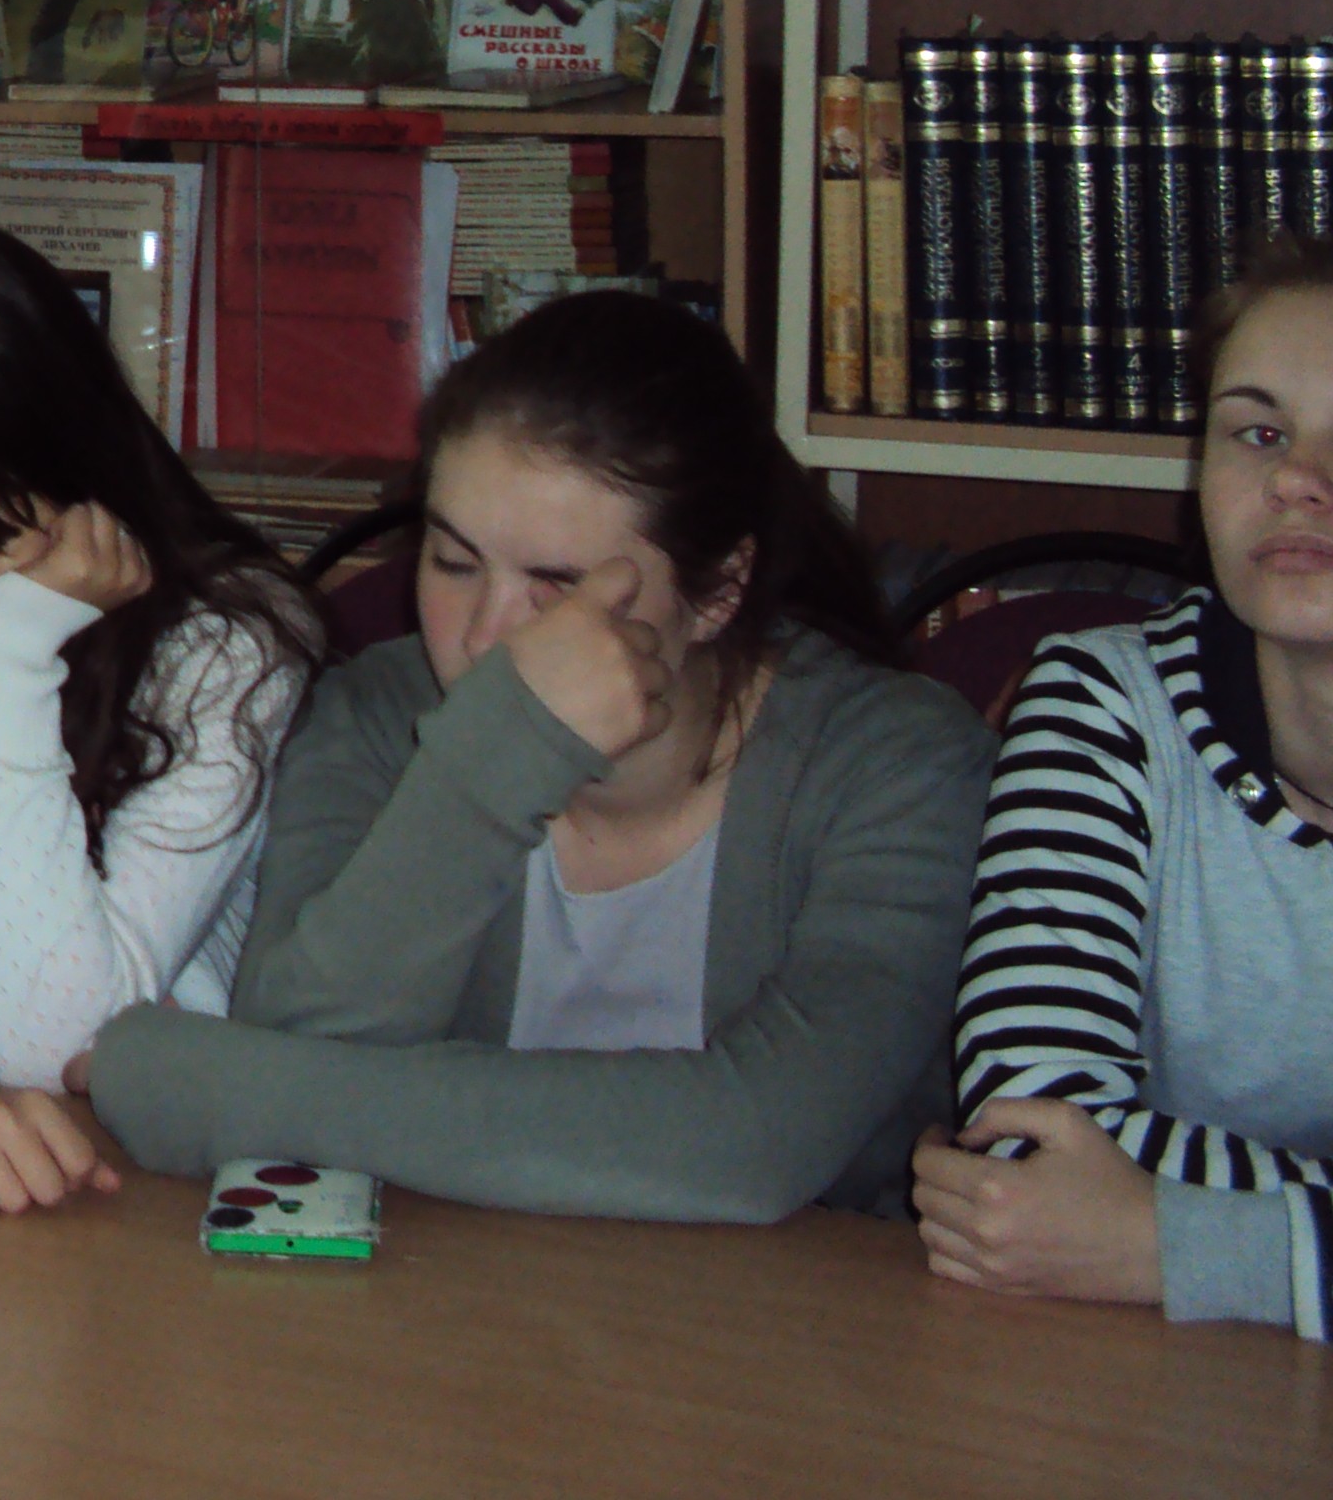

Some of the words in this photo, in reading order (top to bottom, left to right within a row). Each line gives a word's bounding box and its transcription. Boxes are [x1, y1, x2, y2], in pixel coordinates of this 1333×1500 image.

[458, 23, 564, 39] СМЕШНЫЕ
[516, 56, 528, 70] О
[534, 57, 603, 72] ШКОЛЕ
[933, 158, 954, 301] ЭНЦИКЛОПЕДИЯ
[985, 158, 1006, 302] ЭНЦИКЛОПЕДИЯ
[1077, 162, 1099, 308] ЭНЦИКЛОПЕДИЯ
